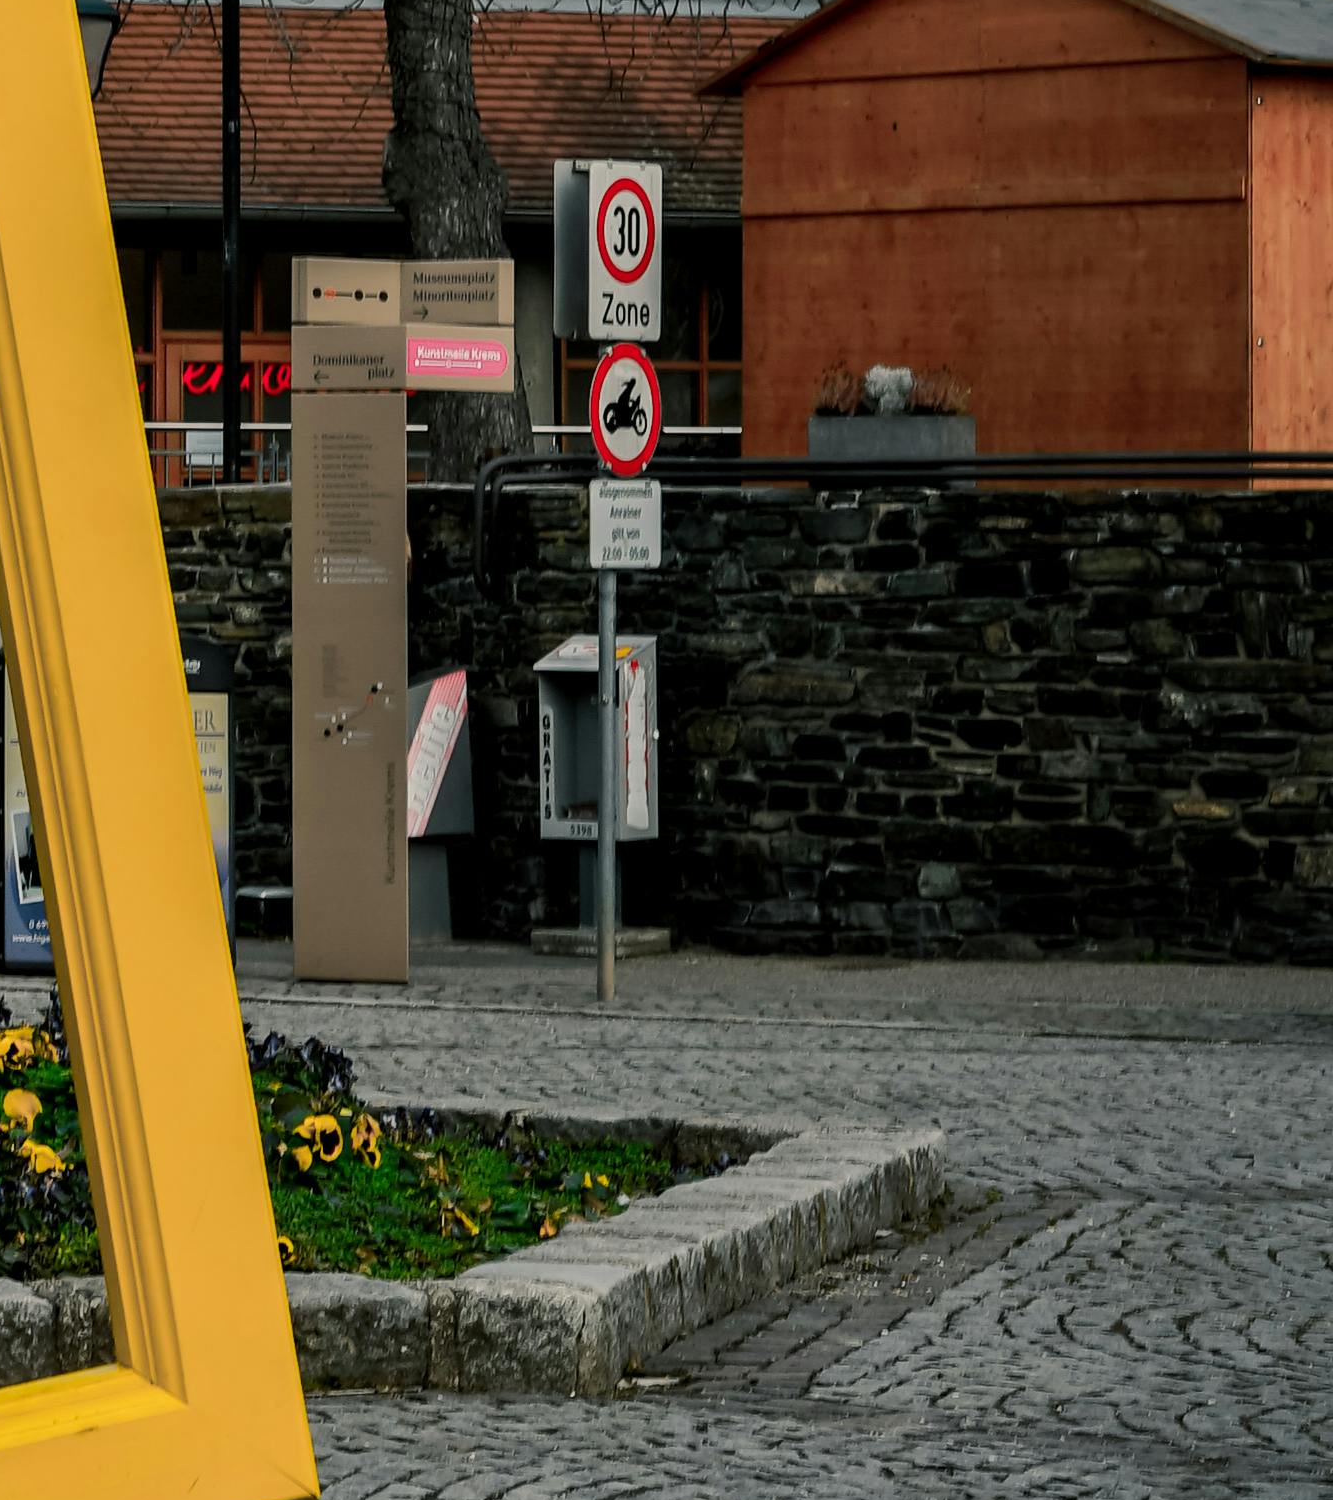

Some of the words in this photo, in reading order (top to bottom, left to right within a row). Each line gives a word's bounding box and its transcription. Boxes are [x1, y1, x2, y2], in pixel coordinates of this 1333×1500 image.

[613, 206, 641, 257] 30
[412, 271, 496, 286] Museumsplatz
[412, 290, 496, 304] Minoritenplatz
[602, 293, 650, 327] Zone
[312, 354, 385, 367] Dominikaner
[417, 345, 470, 360] Kunstmeile
[471, 347, 502, 362] Krems
[367, 366, 396, 381] platz
[541, 714, 552, 820] GRATIS
